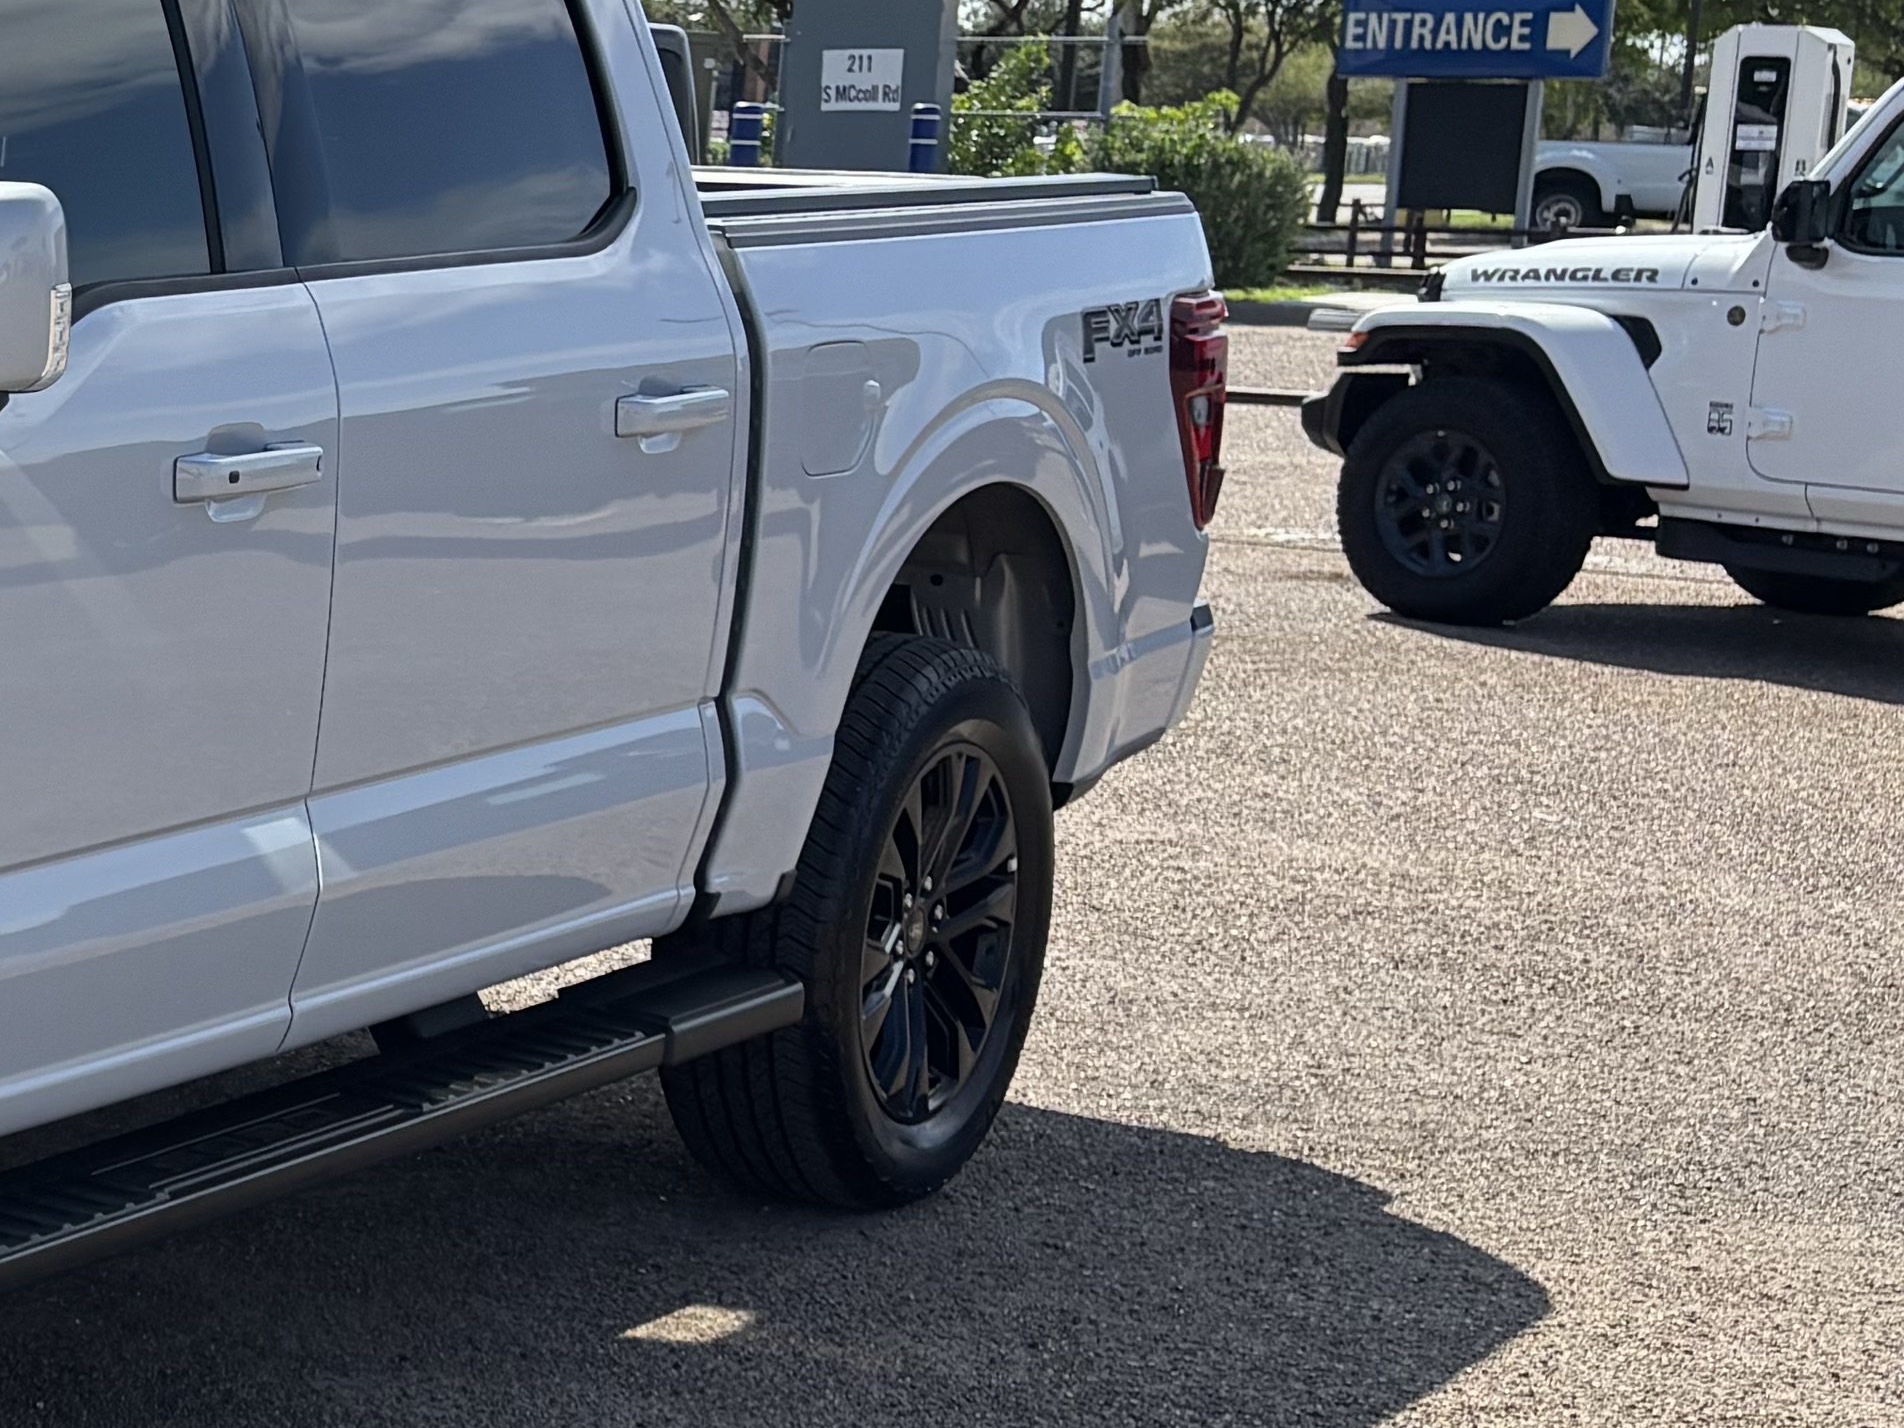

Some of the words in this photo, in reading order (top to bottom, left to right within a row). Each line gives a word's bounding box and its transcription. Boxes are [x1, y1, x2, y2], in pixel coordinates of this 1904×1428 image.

[1344, 11, 1534, 50] ENTRANCE
[847, 54, 872, 73] 211
[823, 84, 832, 104] S
[882, 83, 900, 104] Rd
[1471, 267, 1660, 283] WRANGLER
[1081, 298, 1163, 364] FX4
